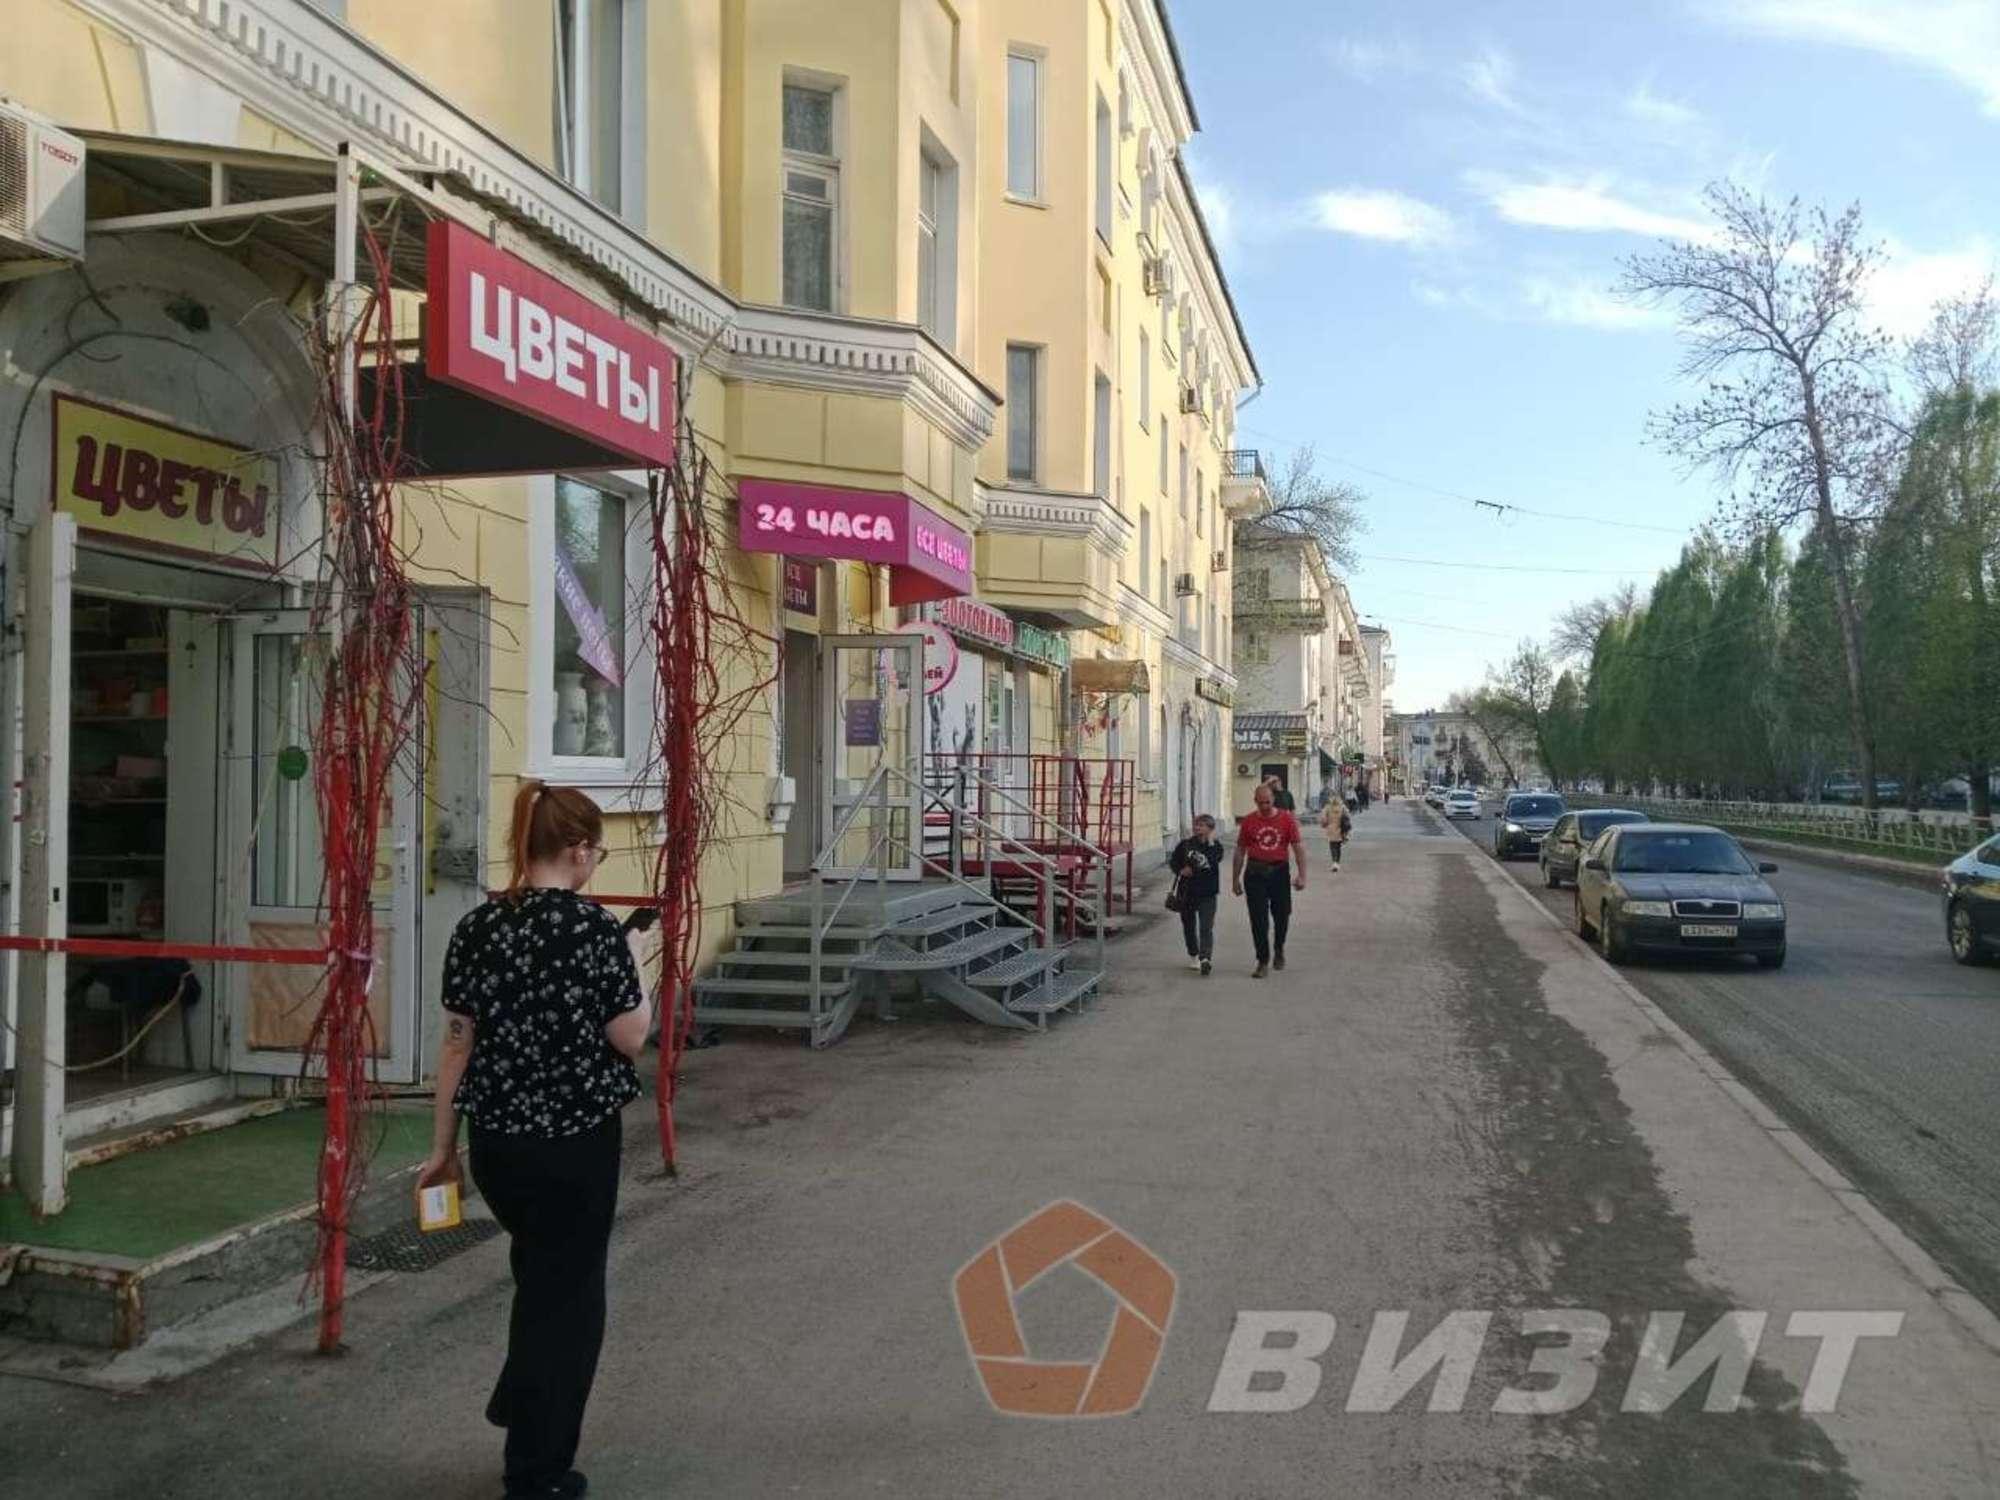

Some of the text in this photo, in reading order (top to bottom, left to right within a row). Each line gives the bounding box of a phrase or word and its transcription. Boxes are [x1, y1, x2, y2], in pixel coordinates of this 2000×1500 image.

[470, 271, 661, 433] ЦВЕТЫ
[72, 434, 269, 539] ЦВЕТЫ
[757, 503, 895, 542] 24 ЧАСА
[1234, 731, 1272, 743] ЫБА
